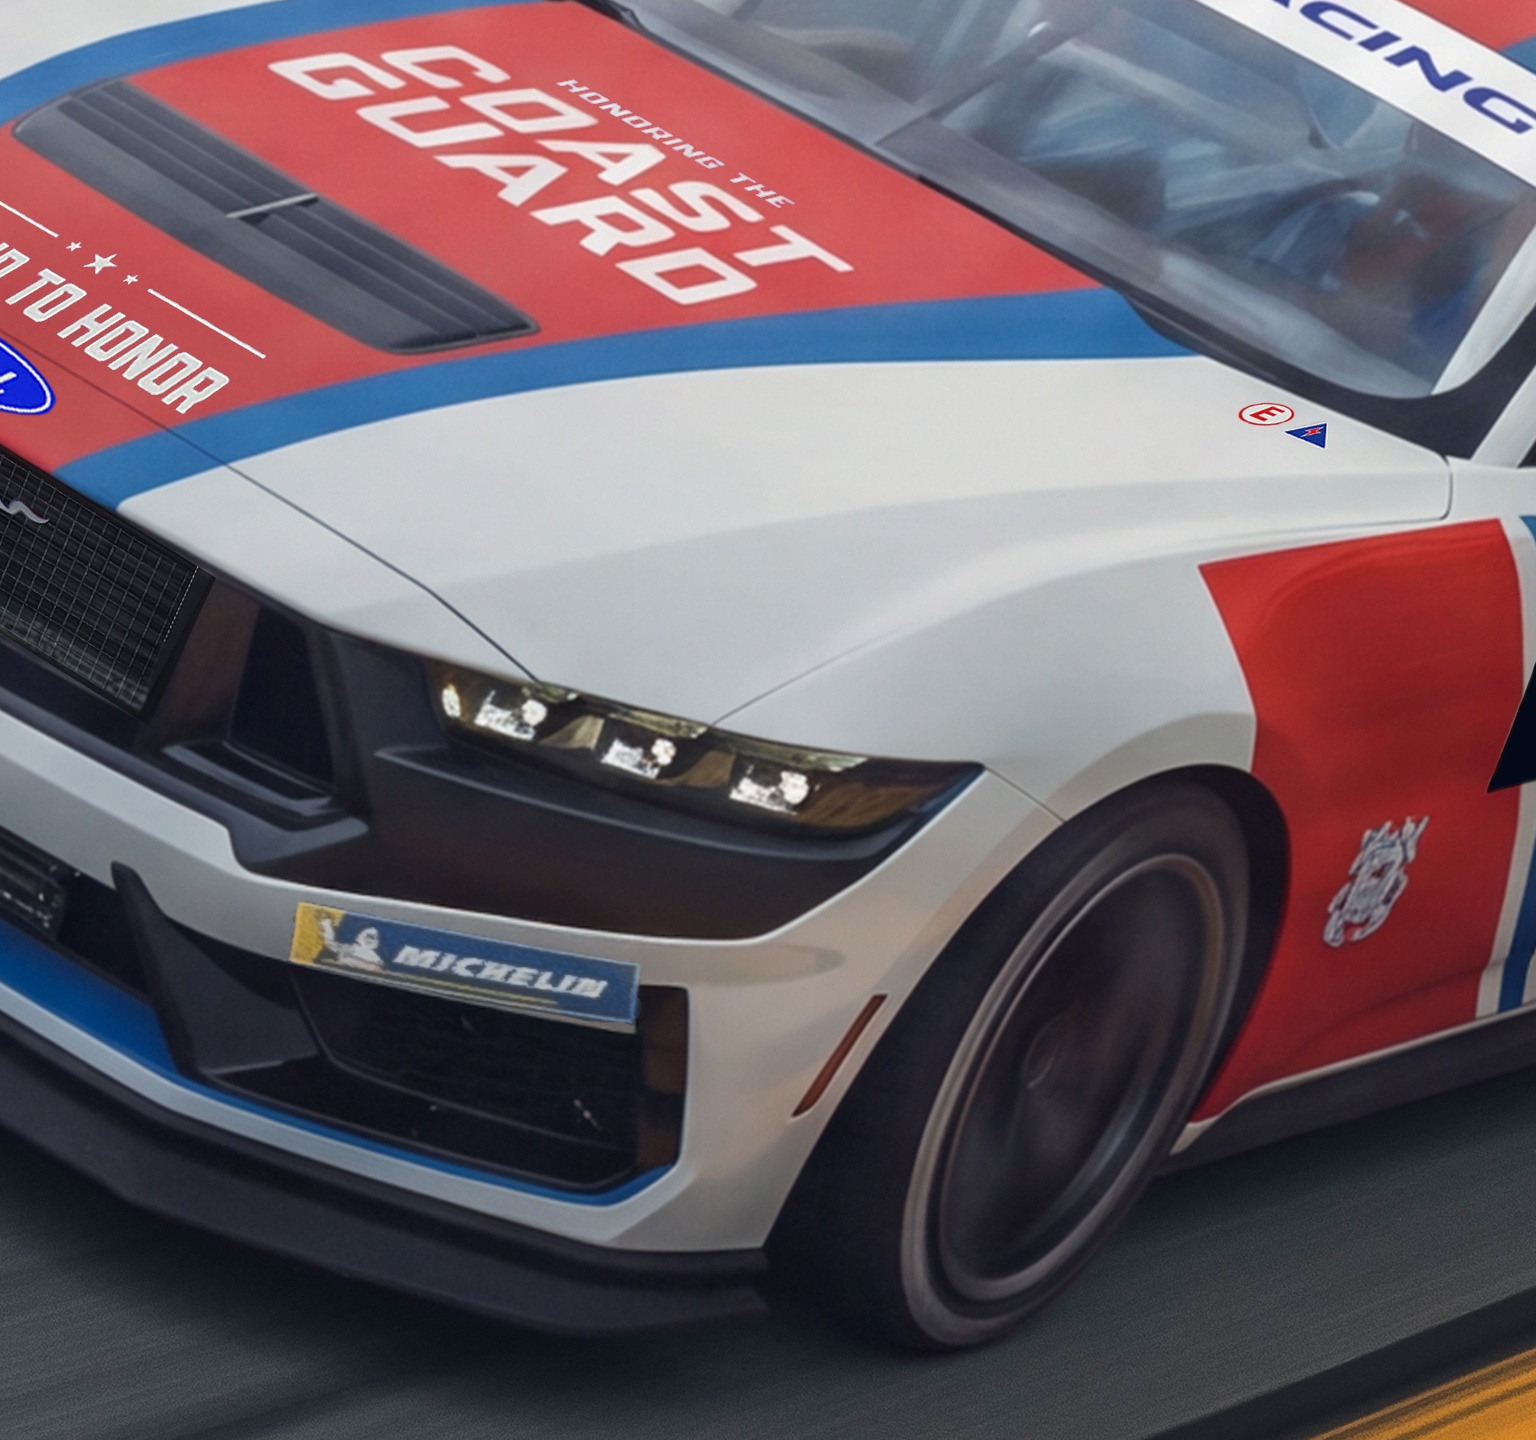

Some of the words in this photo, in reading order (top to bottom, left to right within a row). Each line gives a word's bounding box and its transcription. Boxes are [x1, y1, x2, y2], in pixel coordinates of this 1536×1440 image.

[267, 52, 758, 305] GUARD
[380, 45, 854, 272] COAST
[556, 79, 726, 169] HONORING
[729, 172, 795, 209] THE
[4, 268, 88, 323] TO
[57, 303, 230, 414] HONOR
[1249, 406, 1286, 422] E
[392, 945, 608, 1000] MICHELIN
